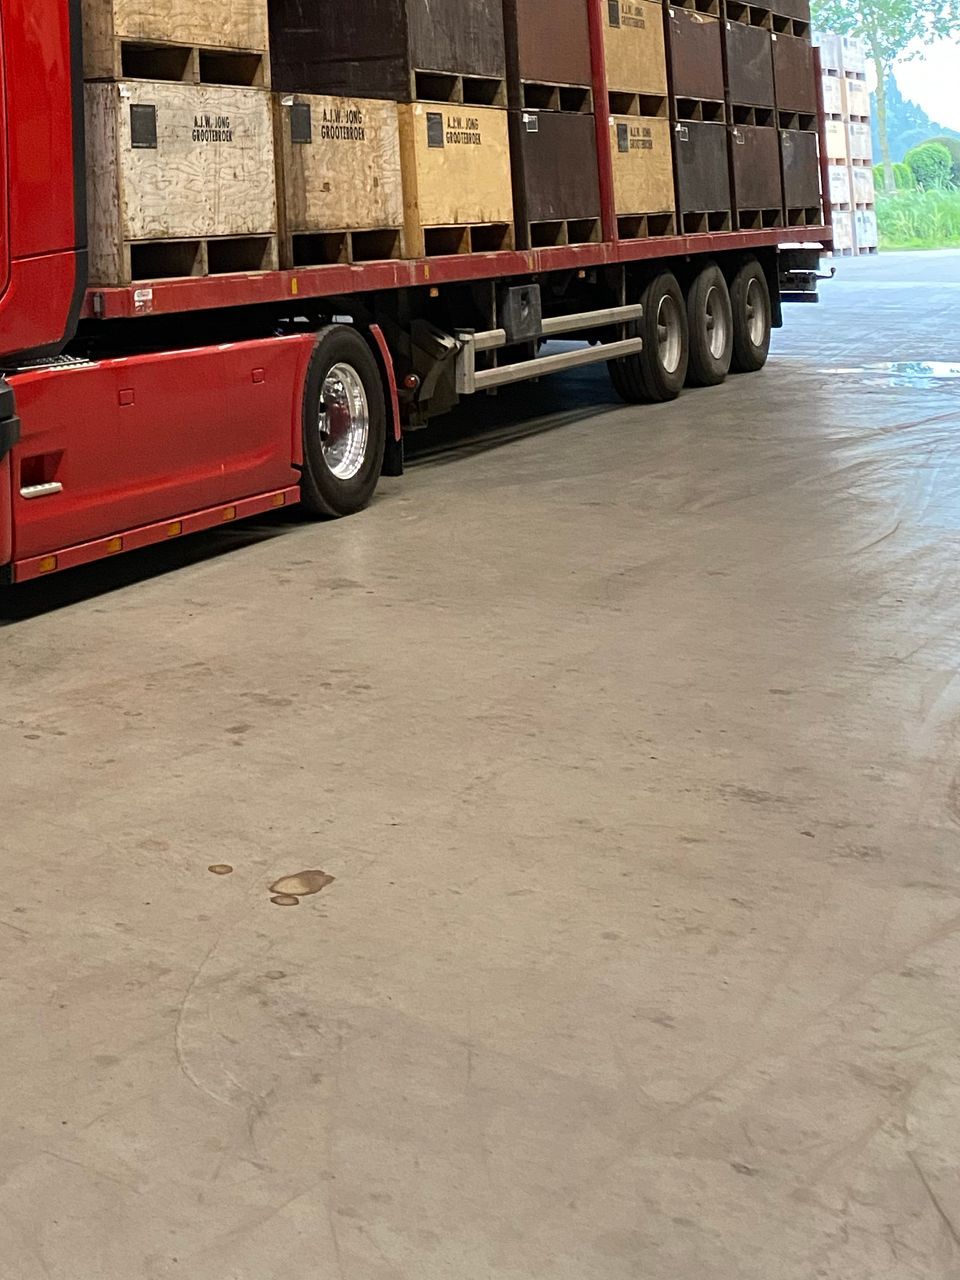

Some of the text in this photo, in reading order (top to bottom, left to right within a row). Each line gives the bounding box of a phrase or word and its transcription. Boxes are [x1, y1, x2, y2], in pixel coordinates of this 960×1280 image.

[322, 108, 363, 124] A.J.W. JONG
[193, 116, 230, 130] A.J.W. JONG
[465, 118, 479, 130] JONG
[192, 129, 232, 142] GROOTEBROEK
[320, 124, 365, 141] GROOTEBROEK
[446, 132, 482, 145] GROOTEBROEK
